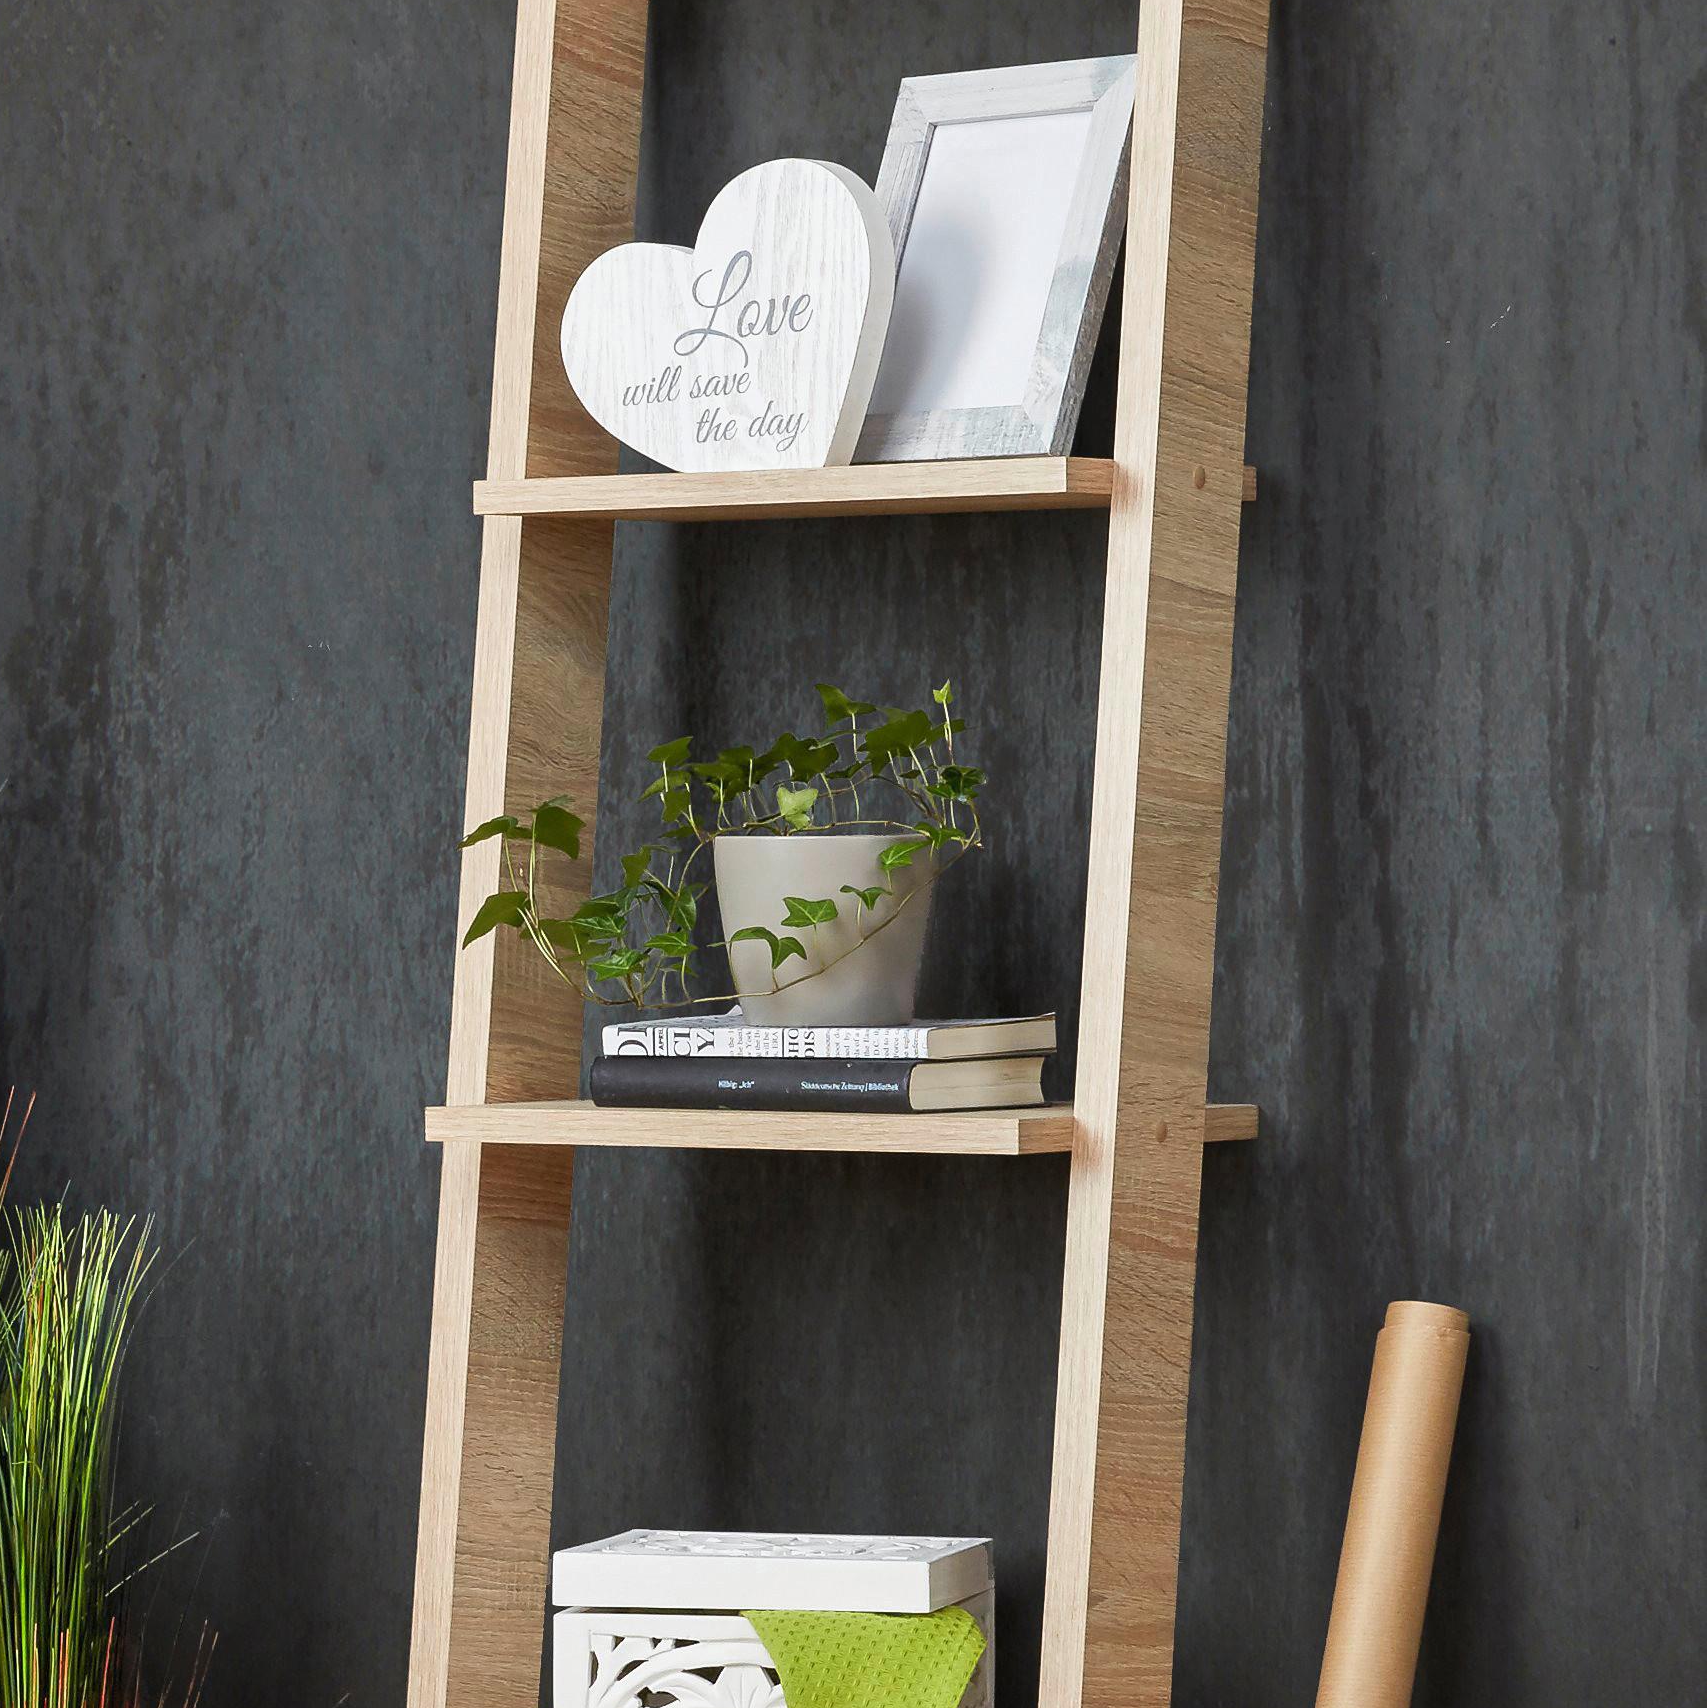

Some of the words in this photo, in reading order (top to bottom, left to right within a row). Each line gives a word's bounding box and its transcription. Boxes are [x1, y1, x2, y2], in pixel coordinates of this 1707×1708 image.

[674, 250, 814, 368] Love
[622, 365, 682, 407] will
[689, 372, 752, 399] save
[695, 407, 738, 443] the
[748, 400, 810, 452] day
